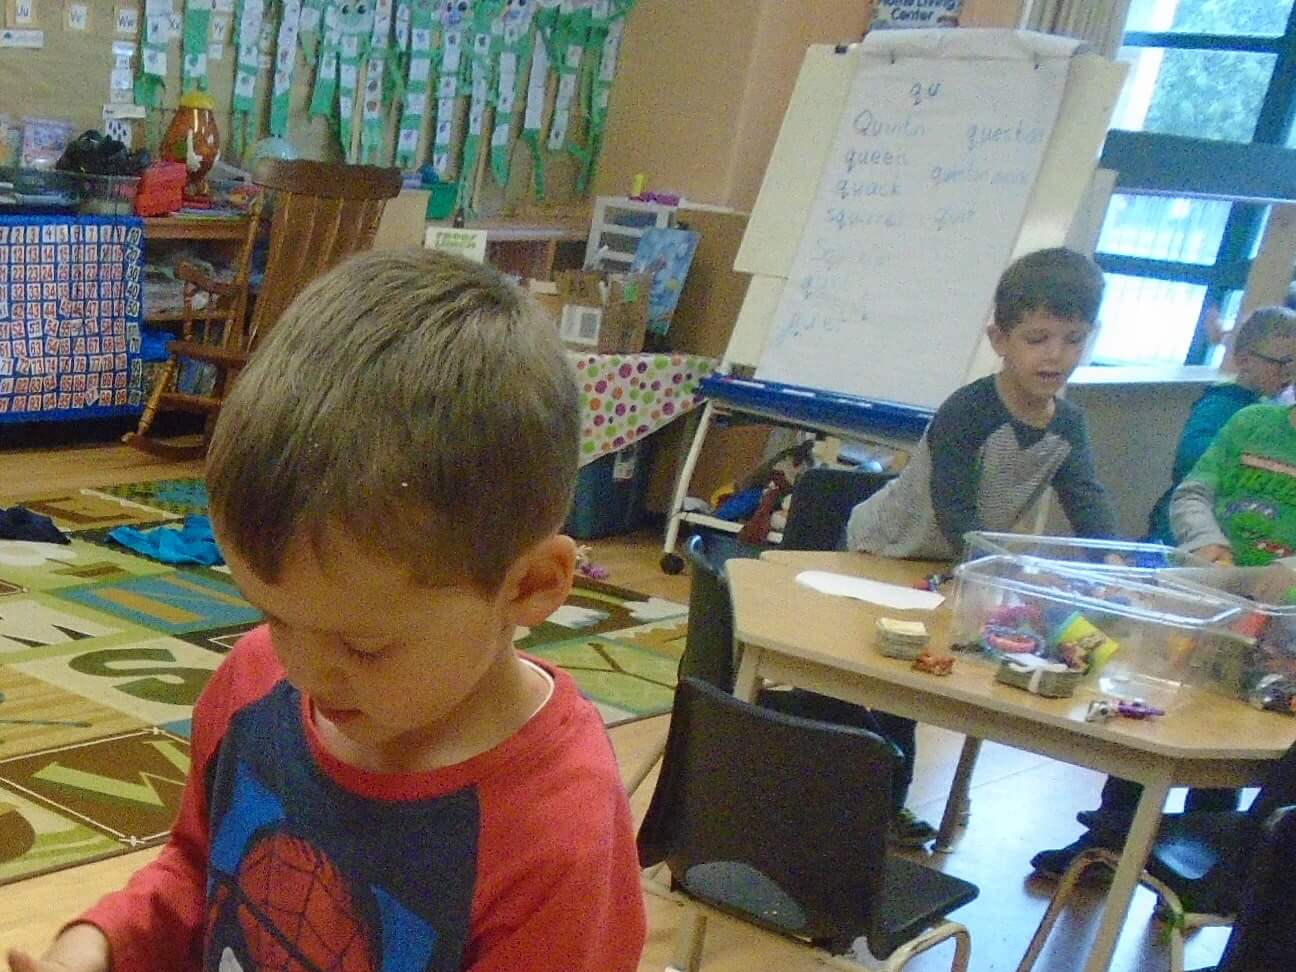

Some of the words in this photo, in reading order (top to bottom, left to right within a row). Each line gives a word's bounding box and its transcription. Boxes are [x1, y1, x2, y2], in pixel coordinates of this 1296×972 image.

[891, 6, 933, 20] Center
[844, 150, 910, 173] queen
[13, 266, 23, 278] 22
[68, 648, 214, 705] S
